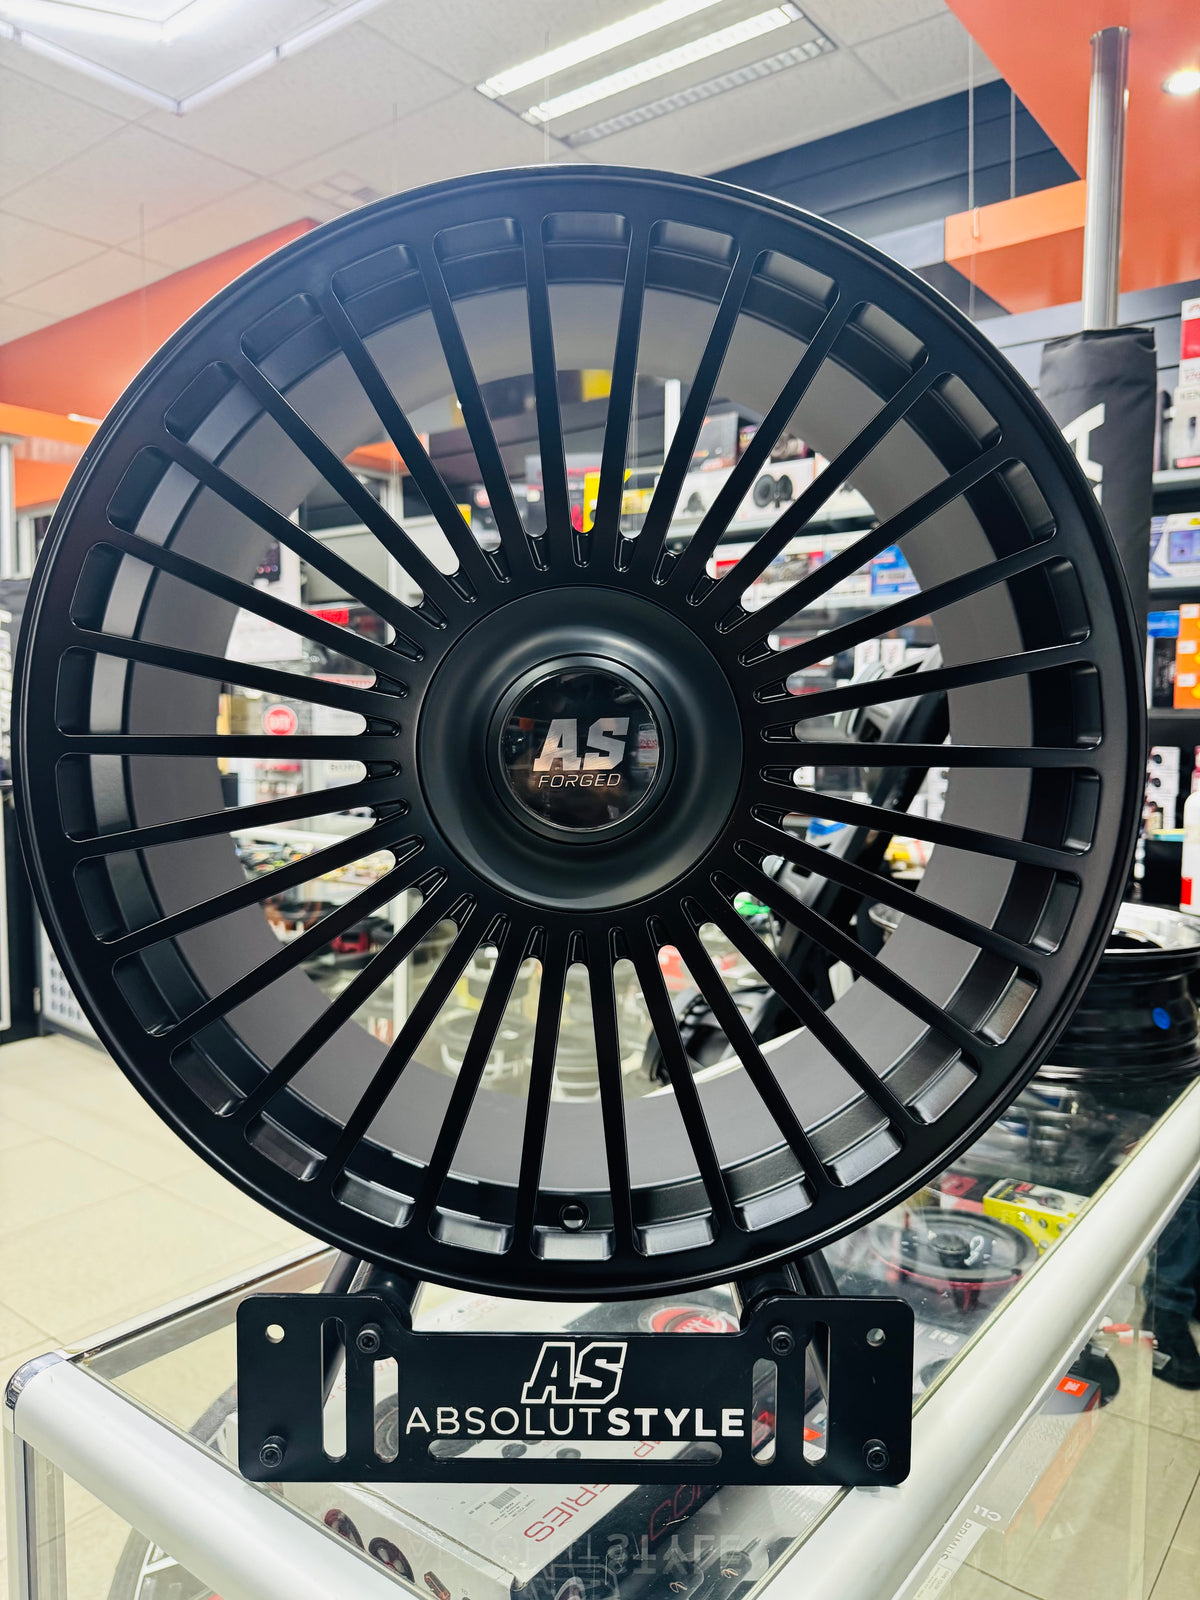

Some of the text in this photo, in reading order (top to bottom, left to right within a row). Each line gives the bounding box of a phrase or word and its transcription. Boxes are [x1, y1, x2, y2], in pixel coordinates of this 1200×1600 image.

[532, 716, 631, 773] AS
[537, 773, 623, 789] FORGED
[520, 1341, 628, 1405] AS
